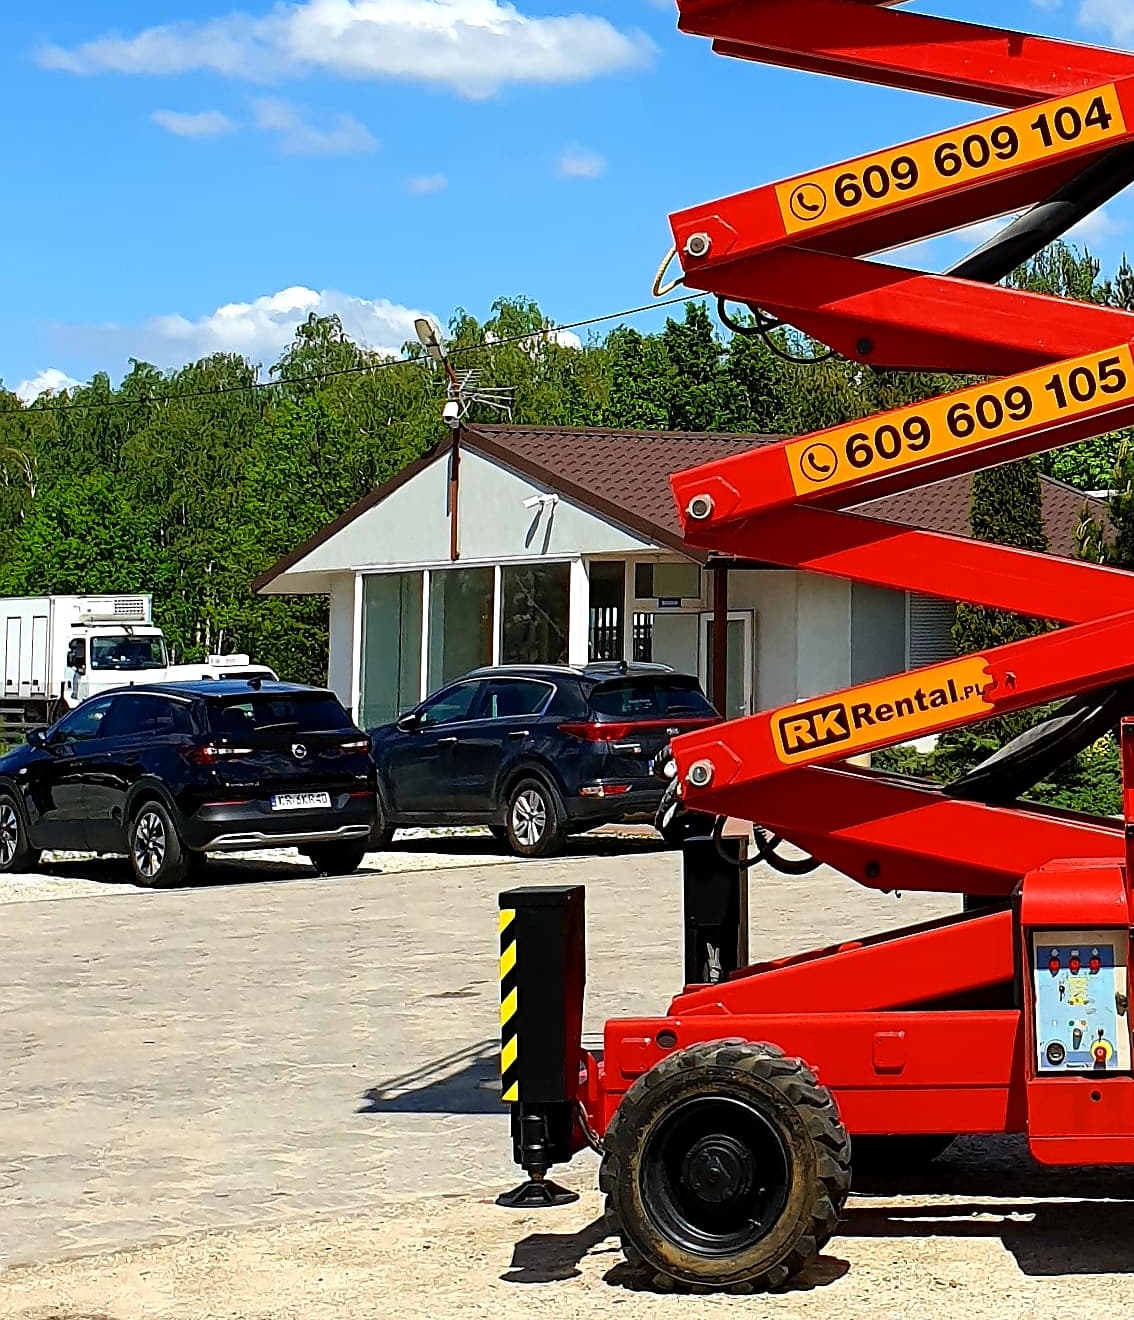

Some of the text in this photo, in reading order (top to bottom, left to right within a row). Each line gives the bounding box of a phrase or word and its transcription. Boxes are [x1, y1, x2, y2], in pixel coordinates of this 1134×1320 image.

[834, 96, 1112, 207] 609 609 104
[845, 356, 1126, 468] 609 609 105
[784, 708, 846, 749] RK
